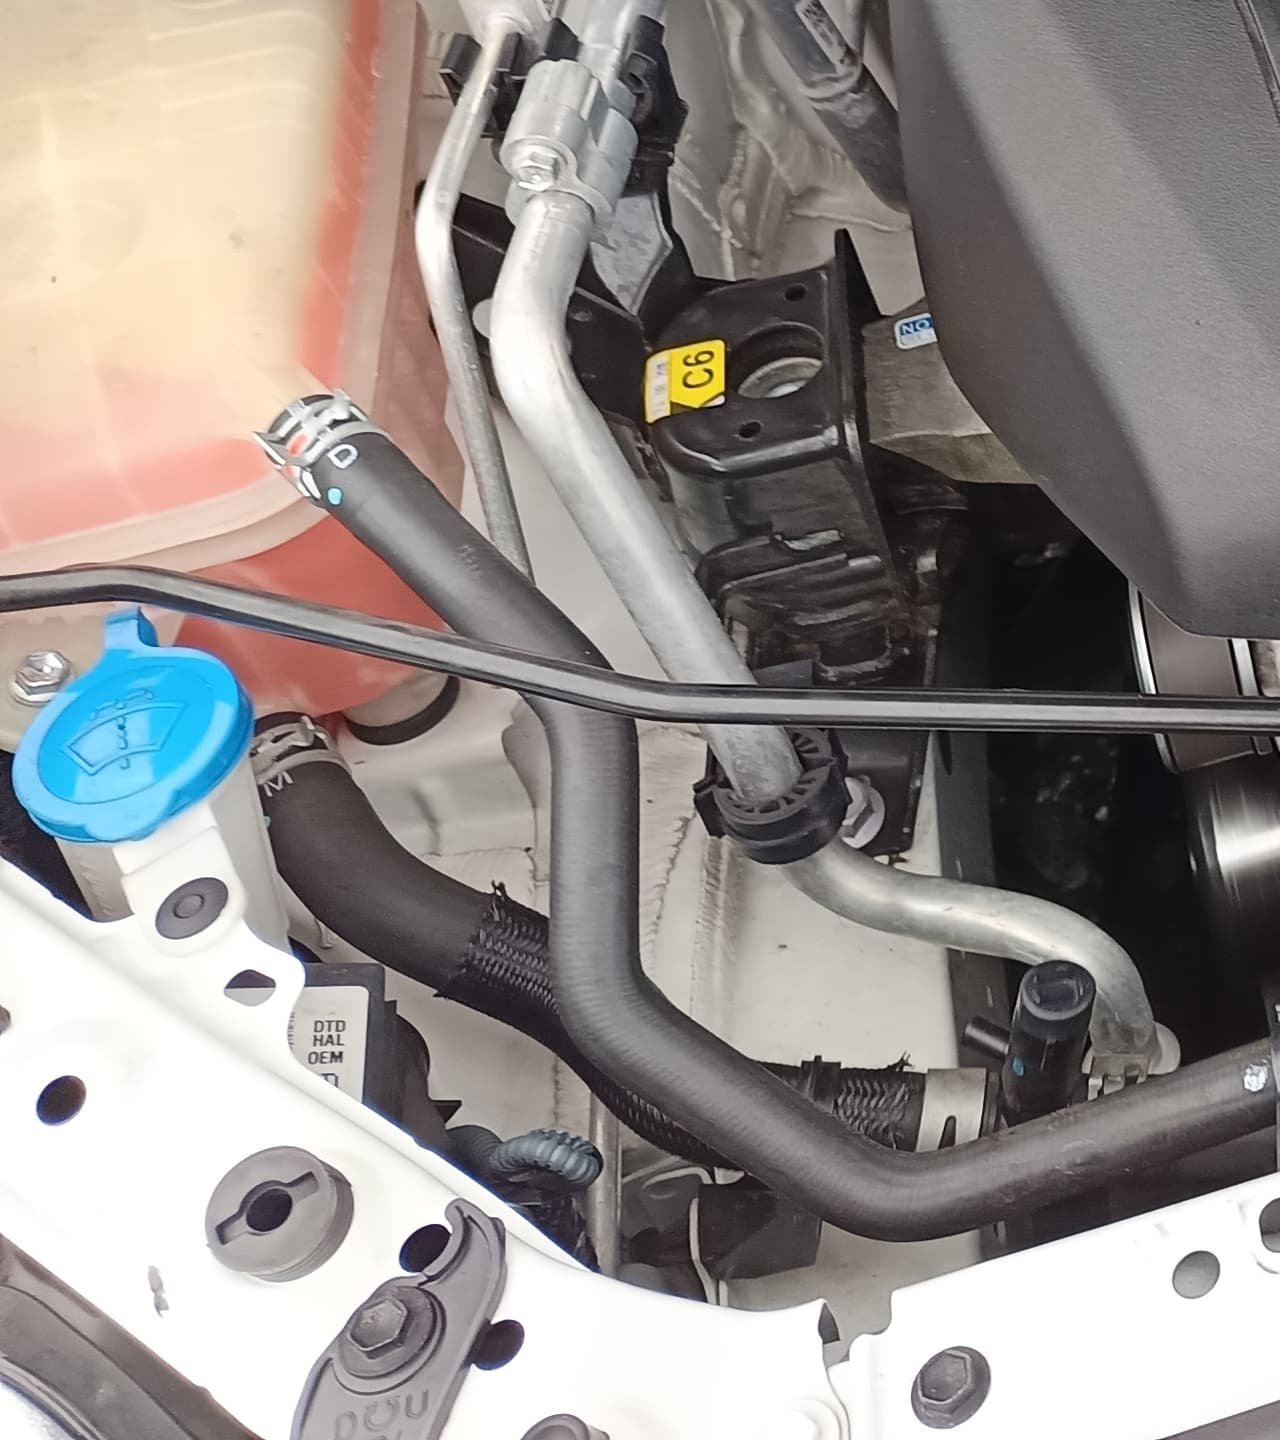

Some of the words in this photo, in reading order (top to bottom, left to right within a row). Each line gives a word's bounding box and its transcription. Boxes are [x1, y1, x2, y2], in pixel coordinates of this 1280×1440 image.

[682, 349, 715, 390] C6
[313, 1020, 347, 1033] DTD
[312, 1034, 345, 1047] HAL
[308, 1051, 344, 1065] OEM
